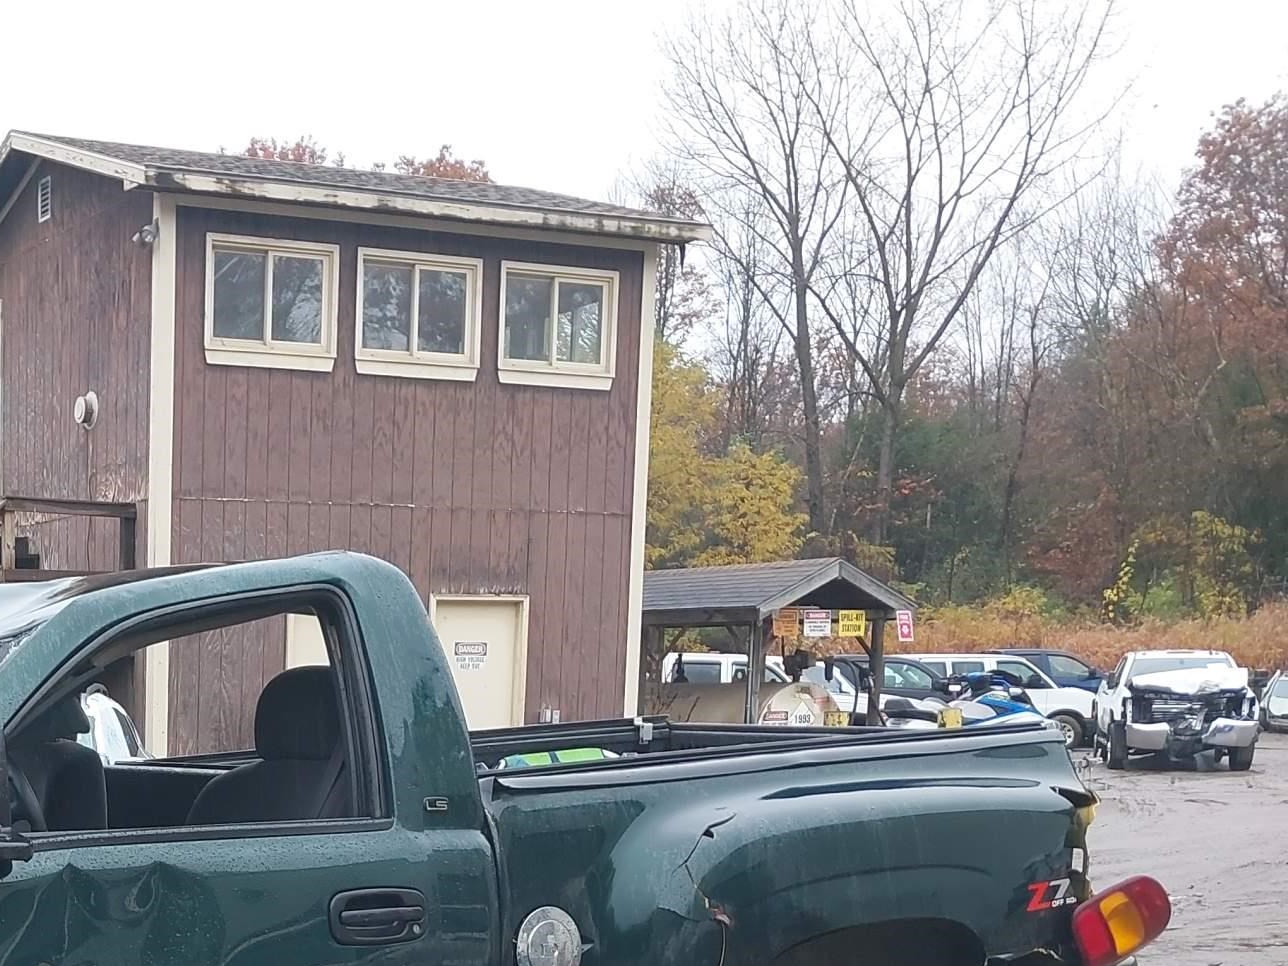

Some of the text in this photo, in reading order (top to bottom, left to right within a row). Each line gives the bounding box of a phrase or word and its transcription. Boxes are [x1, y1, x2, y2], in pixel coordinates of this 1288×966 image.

[841, 613, 864, 622] SPILL-KIT
[841, 624, 862, 633] STATION
[458, 645, 483, 653] DANGER
[794, 714, 811, 724] 1993
